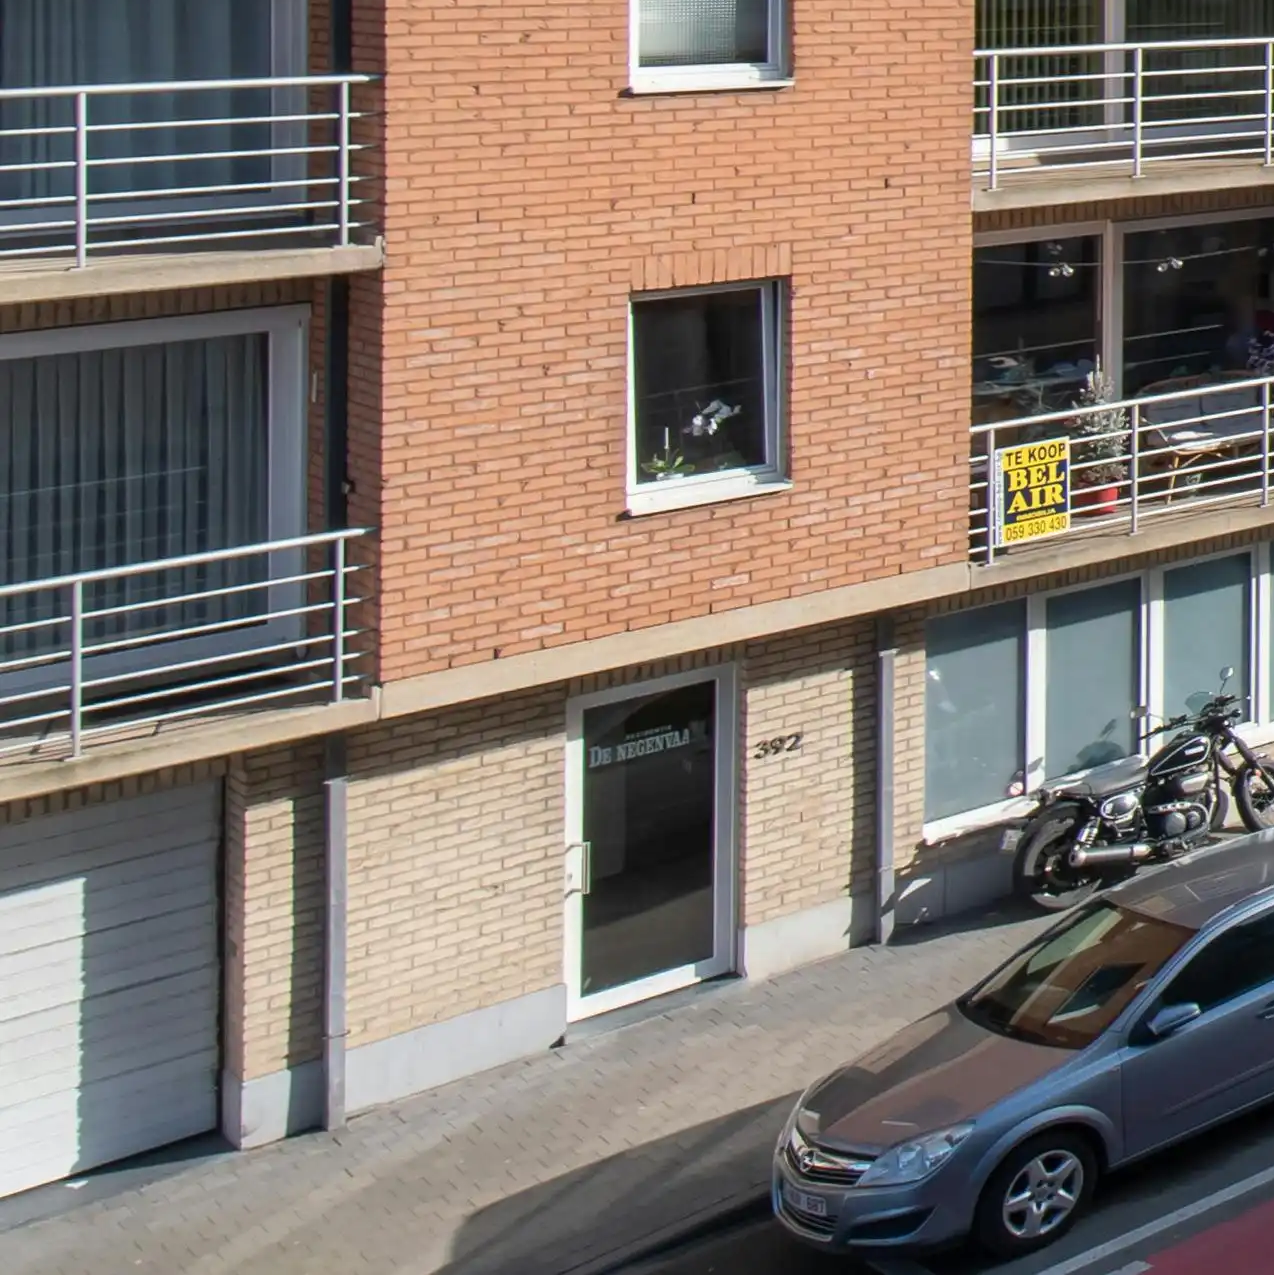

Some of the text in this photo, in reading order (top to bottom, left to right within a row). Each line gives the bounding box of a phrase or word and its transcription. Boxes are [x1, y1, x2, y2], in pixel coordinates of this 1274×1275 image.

[1005, 442, 1066, 466] TE KOOP
[1007, 461, 1065, 492] BEL
[1006, 483, 1066, 515] AIR
[1005, 515, 1067, 541] 059 330 430
[753, 732, 803, 760] 392
